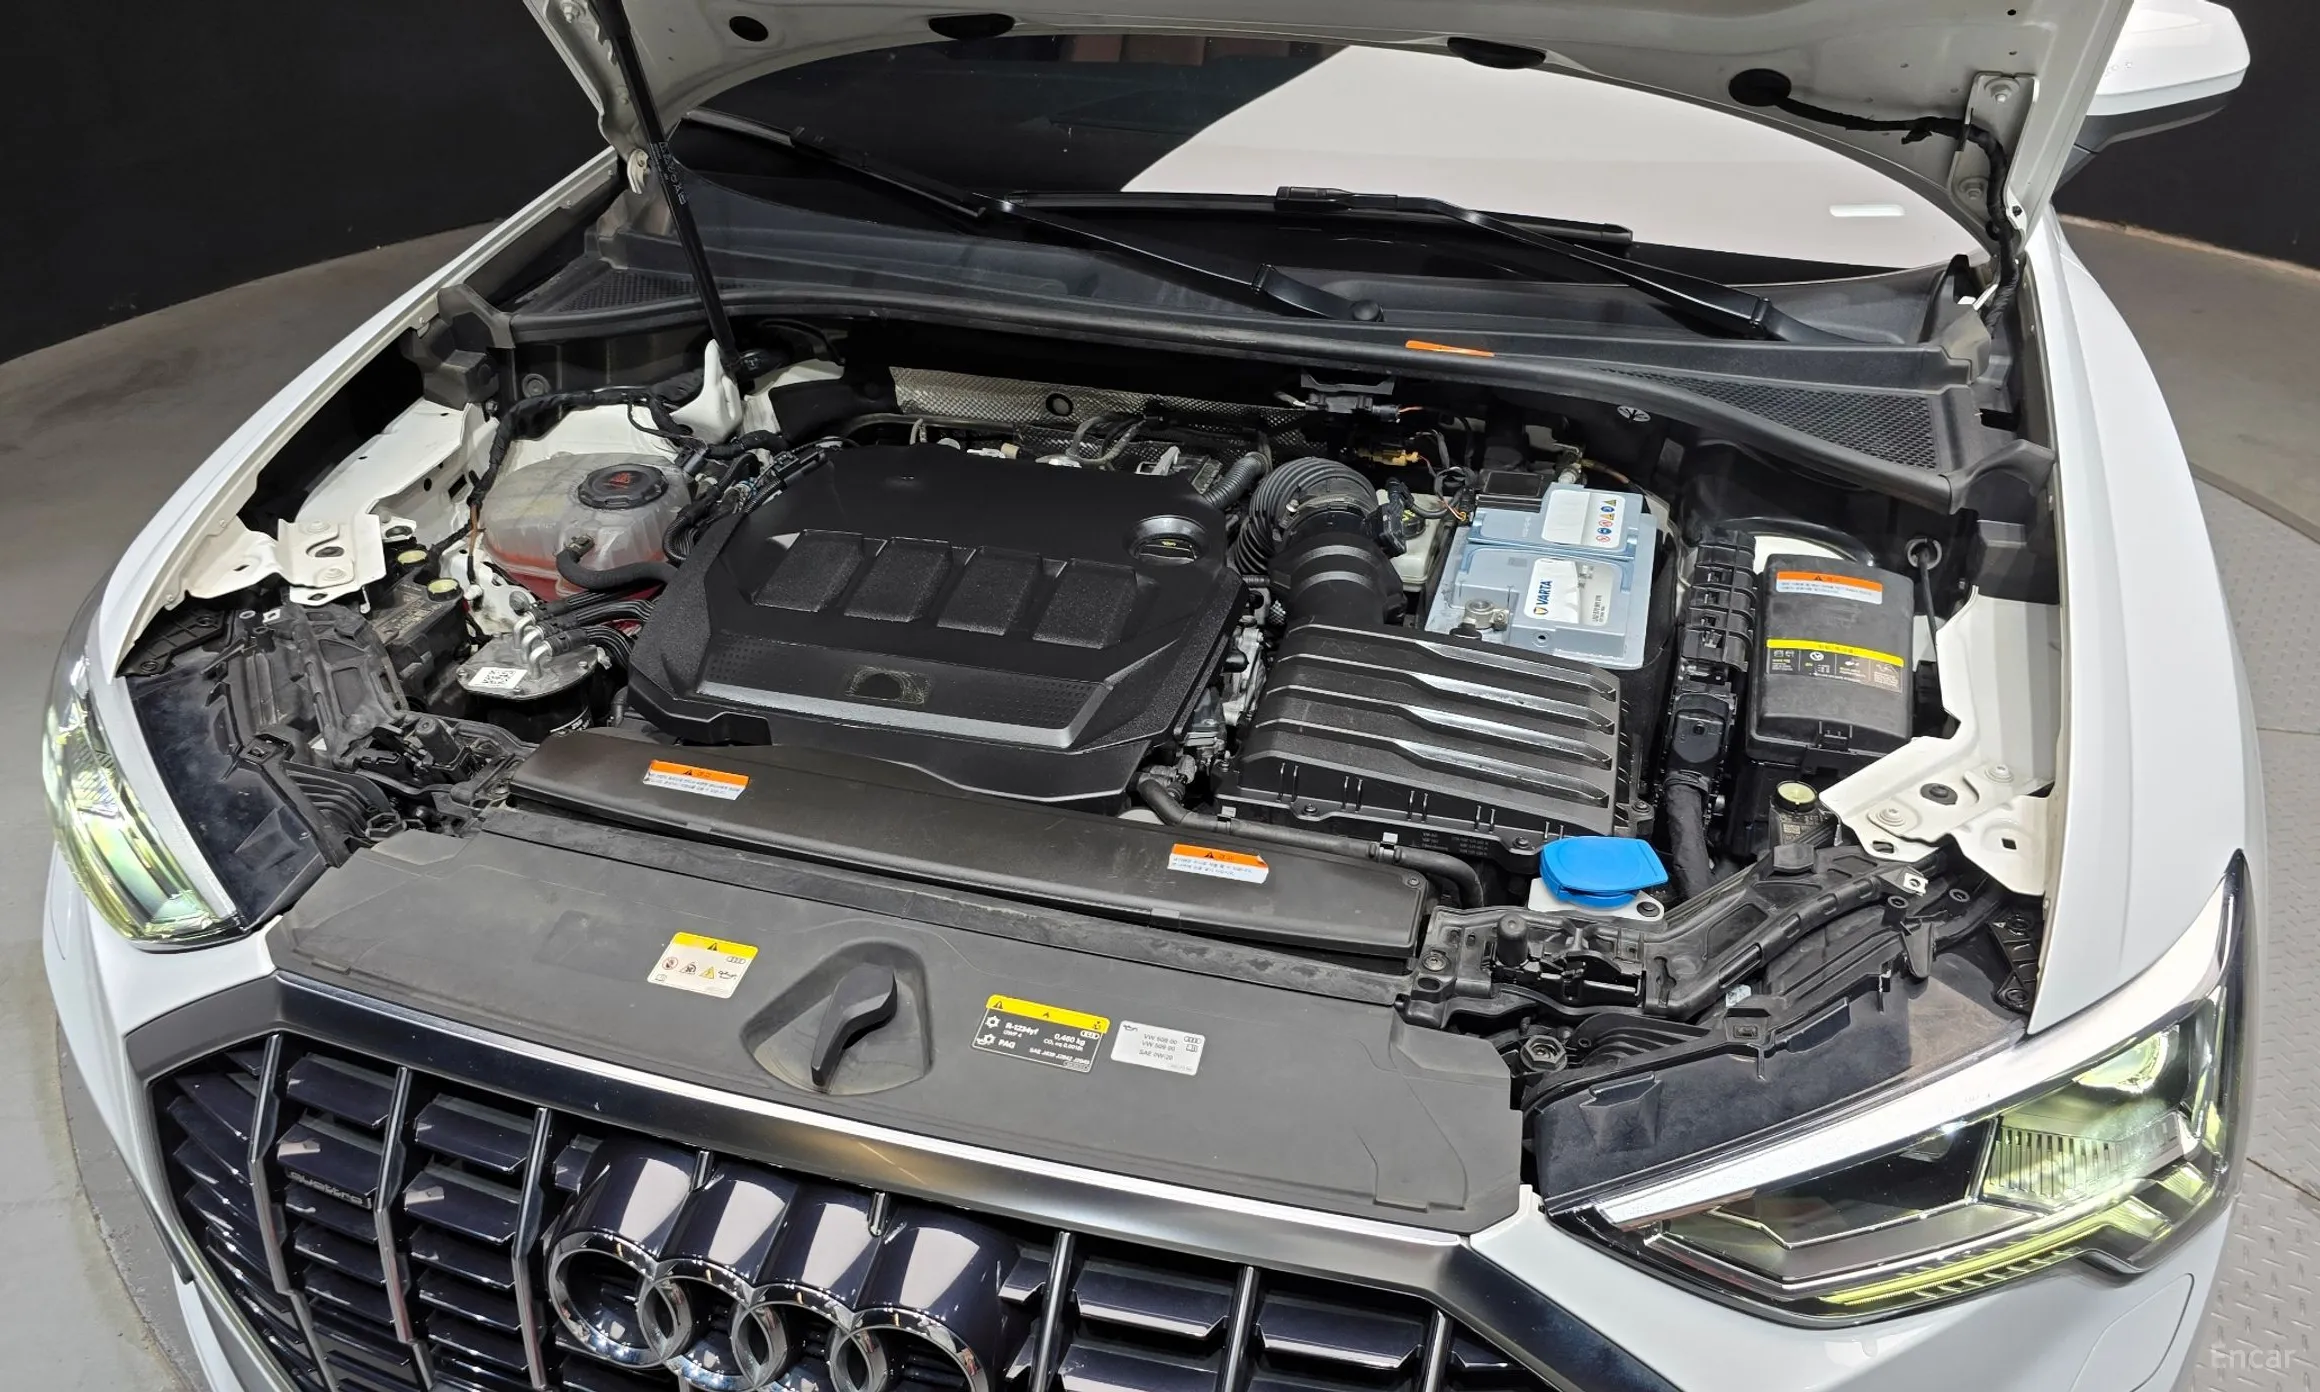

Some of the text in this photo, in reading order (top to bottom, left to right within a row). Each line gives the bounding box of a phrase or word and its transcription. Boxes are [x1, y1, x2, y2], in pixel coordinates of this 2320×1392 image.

[1535, 580, 1553, 605] VARTA
[998, 1039, 1016, 1049] PAG
[1076, 1038, 1086, 1047] kg
[1141, 1040, 1153, 1048] VW
[1029, 1047, 1042, 1055] SAE
[1139, 1049, 1152, 1057] SAE
[290, 1171, 363, 1205] quattro
